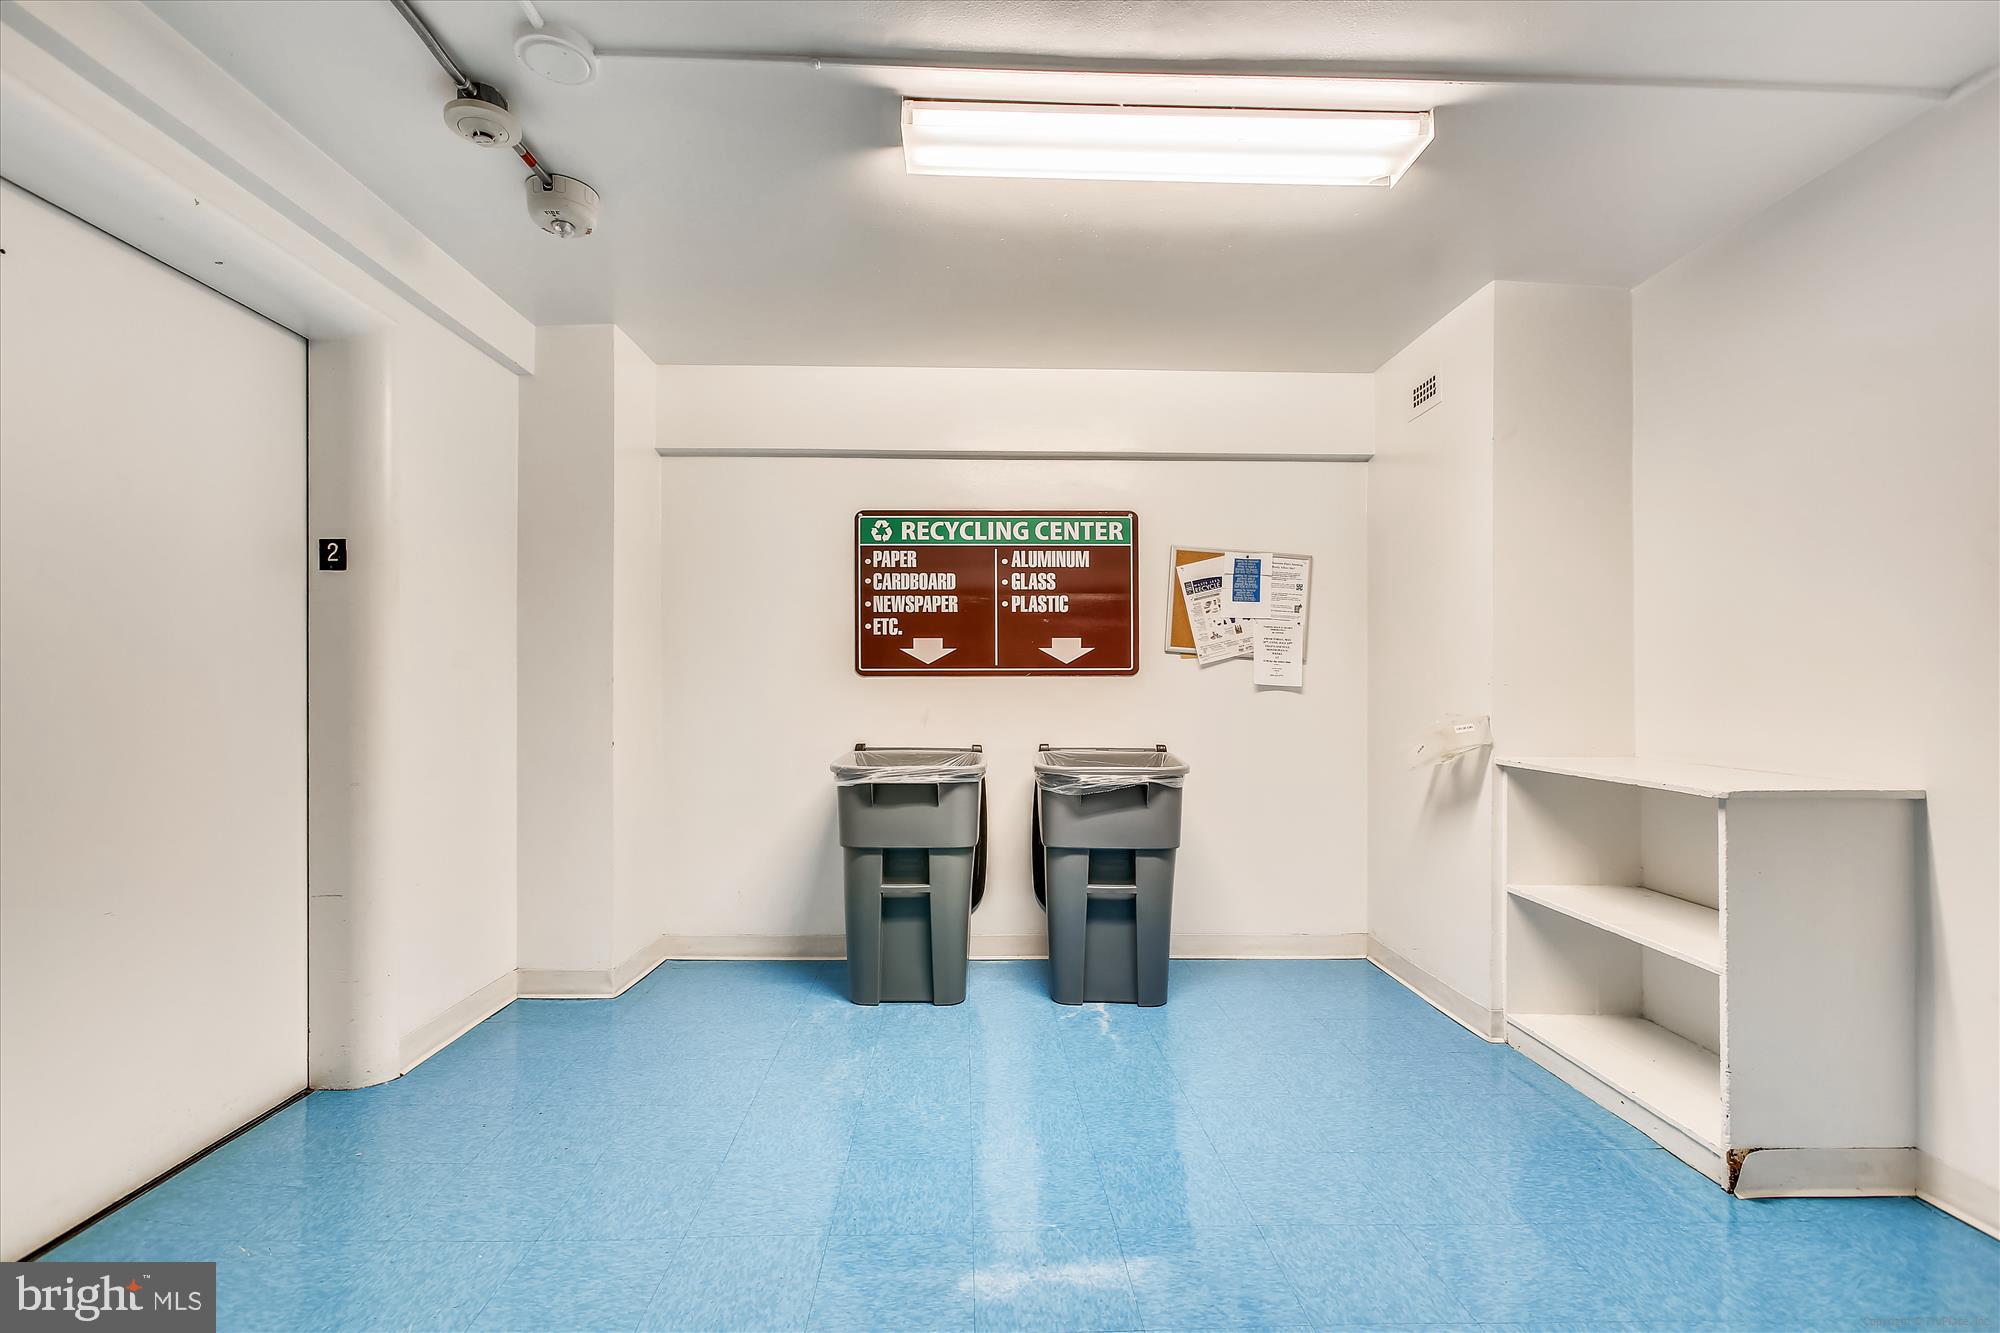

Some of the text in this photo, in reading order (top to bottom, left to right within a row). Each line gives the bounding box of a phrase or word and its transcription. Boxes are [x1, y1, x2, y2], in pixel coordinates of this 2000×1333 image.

[901, 521, 1123, 541] RECYCLING CENTER
[327, 543, 338, 561] 2
[872, 550, 917, 568] PAPER
[1011, 550, 1090, 568] ALUMINUM
[872, 573, 956, 590] CARDBOARD
[1011, 573, 1056, 591] GLASS
[872, 595, 958, 613] NEWSPAPER
[1011, 595, 1069, 613] PLASTIC
[872, 618, 903, 636] ETC.
